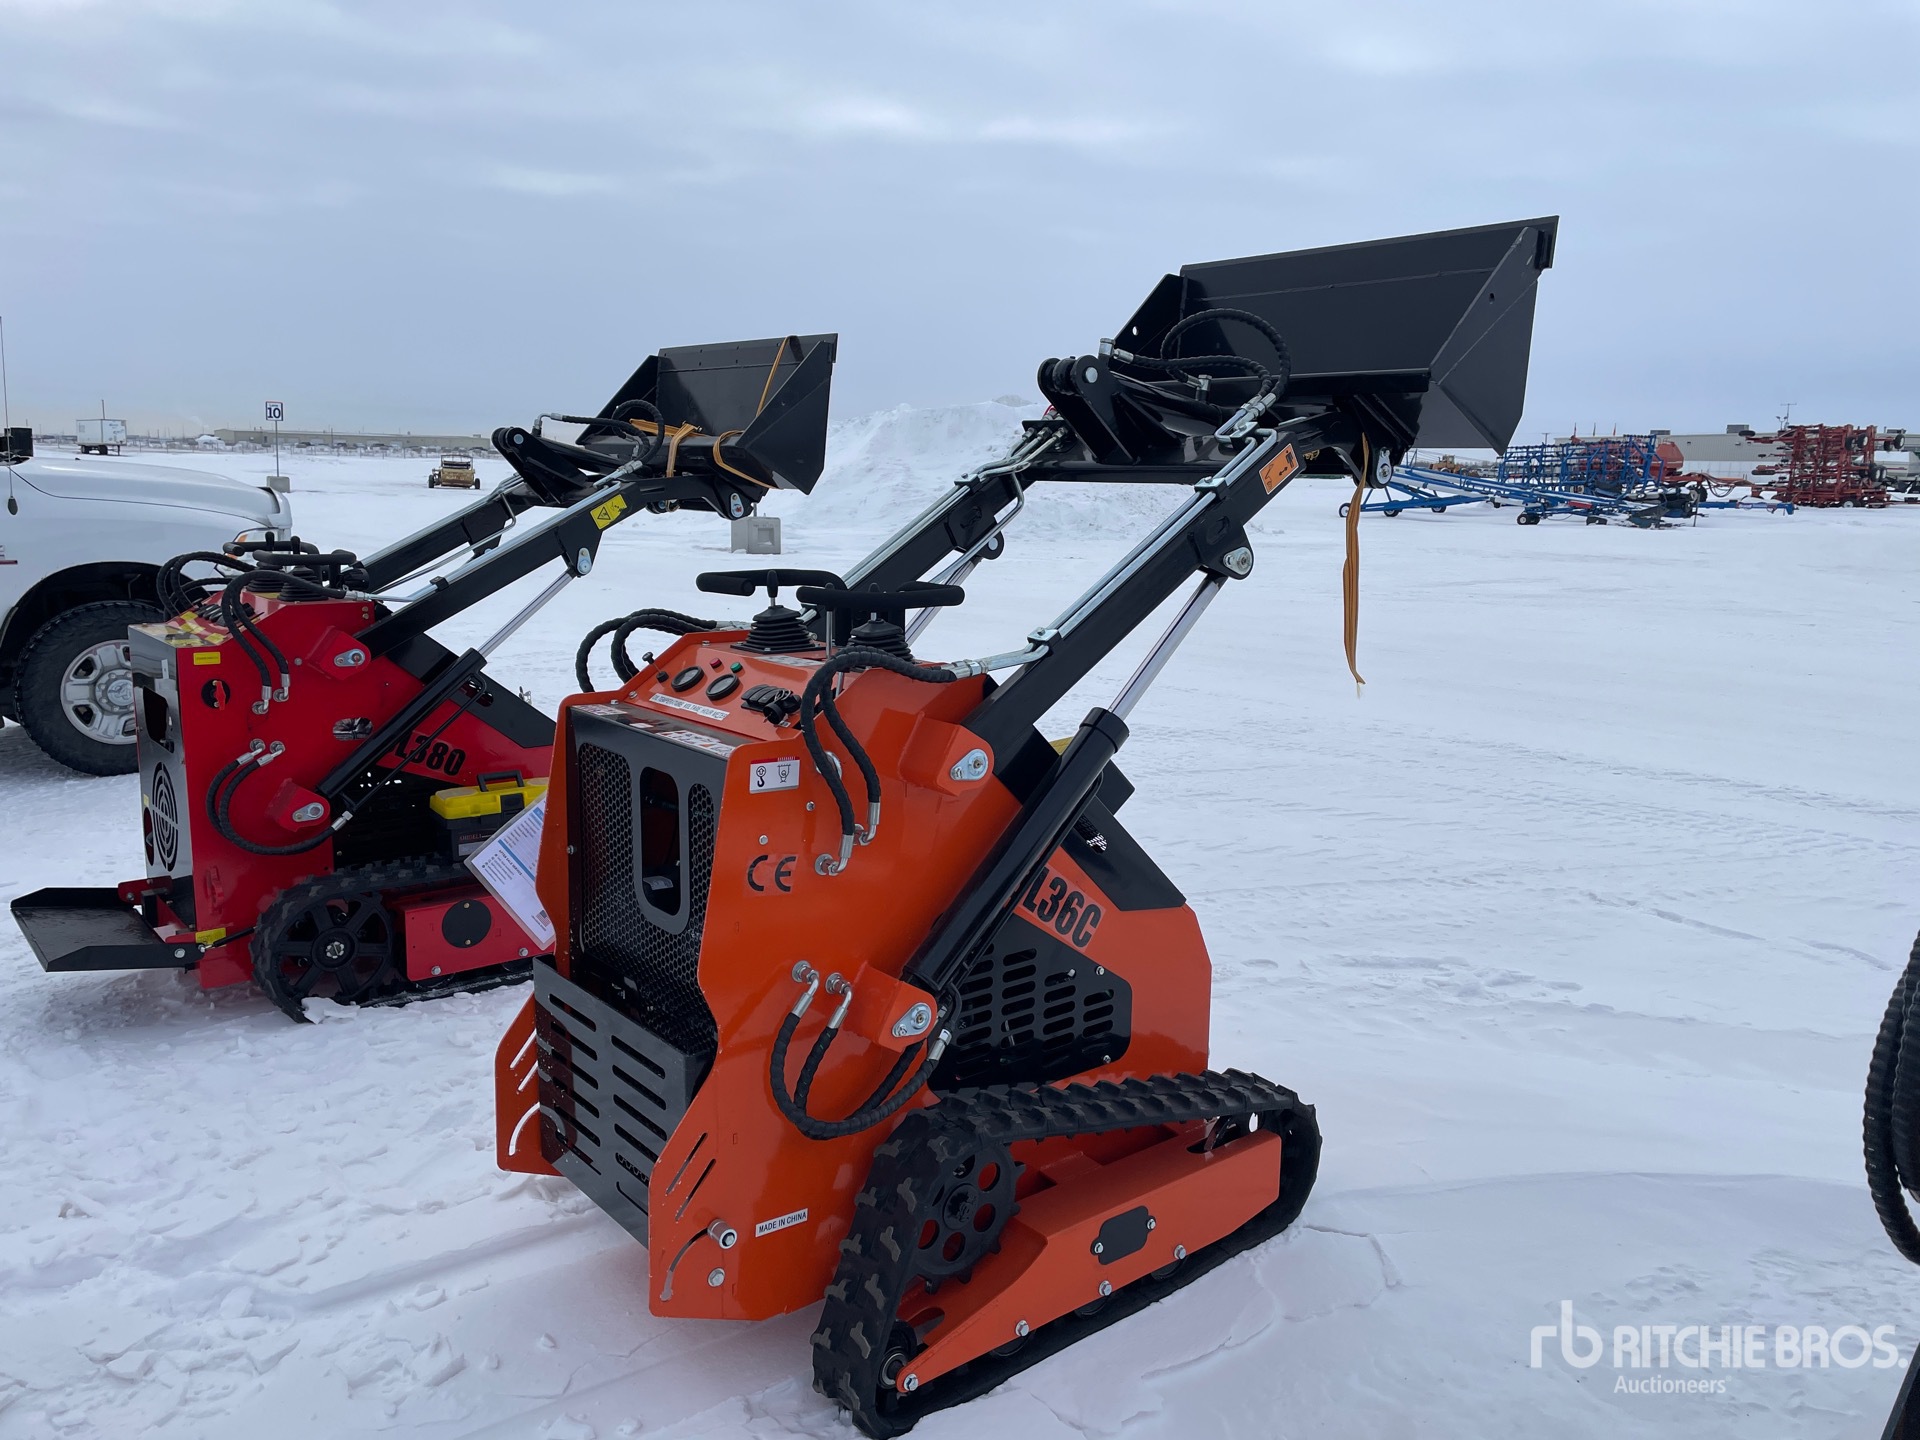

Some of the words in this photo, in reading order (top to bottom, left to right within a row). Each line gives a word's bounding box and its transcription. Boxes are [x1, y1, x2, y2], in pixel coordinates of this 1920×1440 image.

[267, 407, 281, 419] 10
[387, 731, 466, 776] L380
[747, 854, 797, 892] CE
[758, 1221, 777, 1233] MADE
[778, 1217, 786, 1227] IN
[786, 1211, 806, 1224] CHINA
